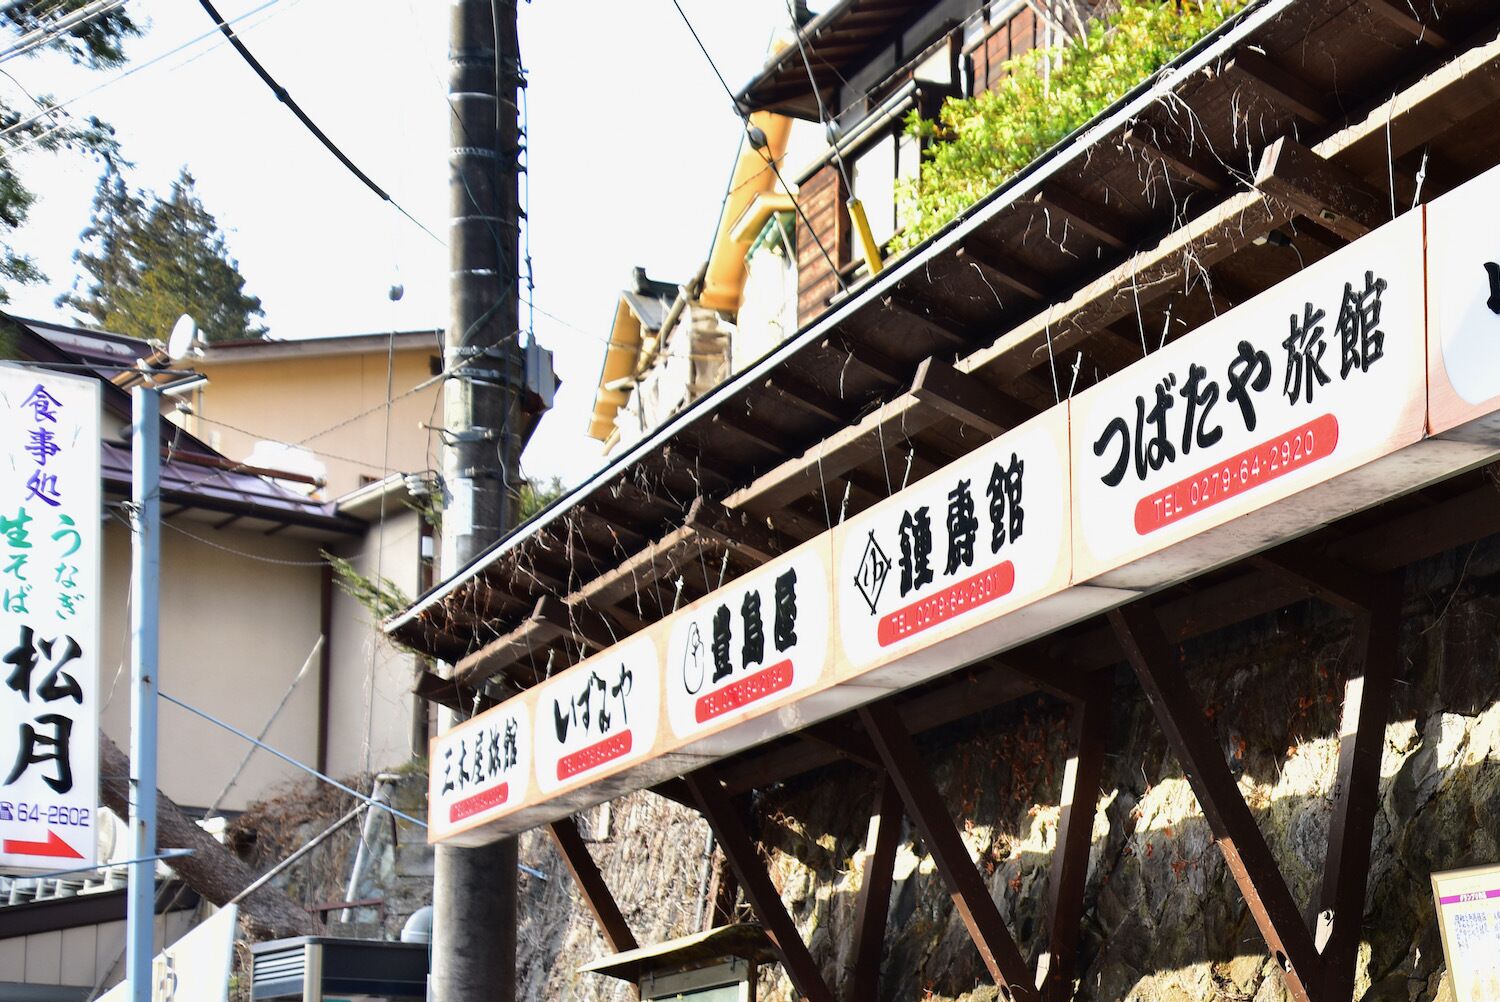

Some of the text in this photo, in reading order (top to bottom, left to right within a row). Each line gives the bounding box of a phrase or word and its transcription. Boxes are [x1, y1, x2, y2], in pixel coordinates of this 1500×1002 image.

[1093, 270, 1388, 487] つばたや旅館
[20, 383, 64, 507] 食事処
[1153, 430, 1316, 522] TEL 0279-64-2920
[0, 506, 33, 615] 生そば
[51, 513, 85, 620] うなぎ
[891, 613, 912, 634] TEL
[1, 624, 83, 794] 松月
[18, 802, 90, 828] 64-2602
